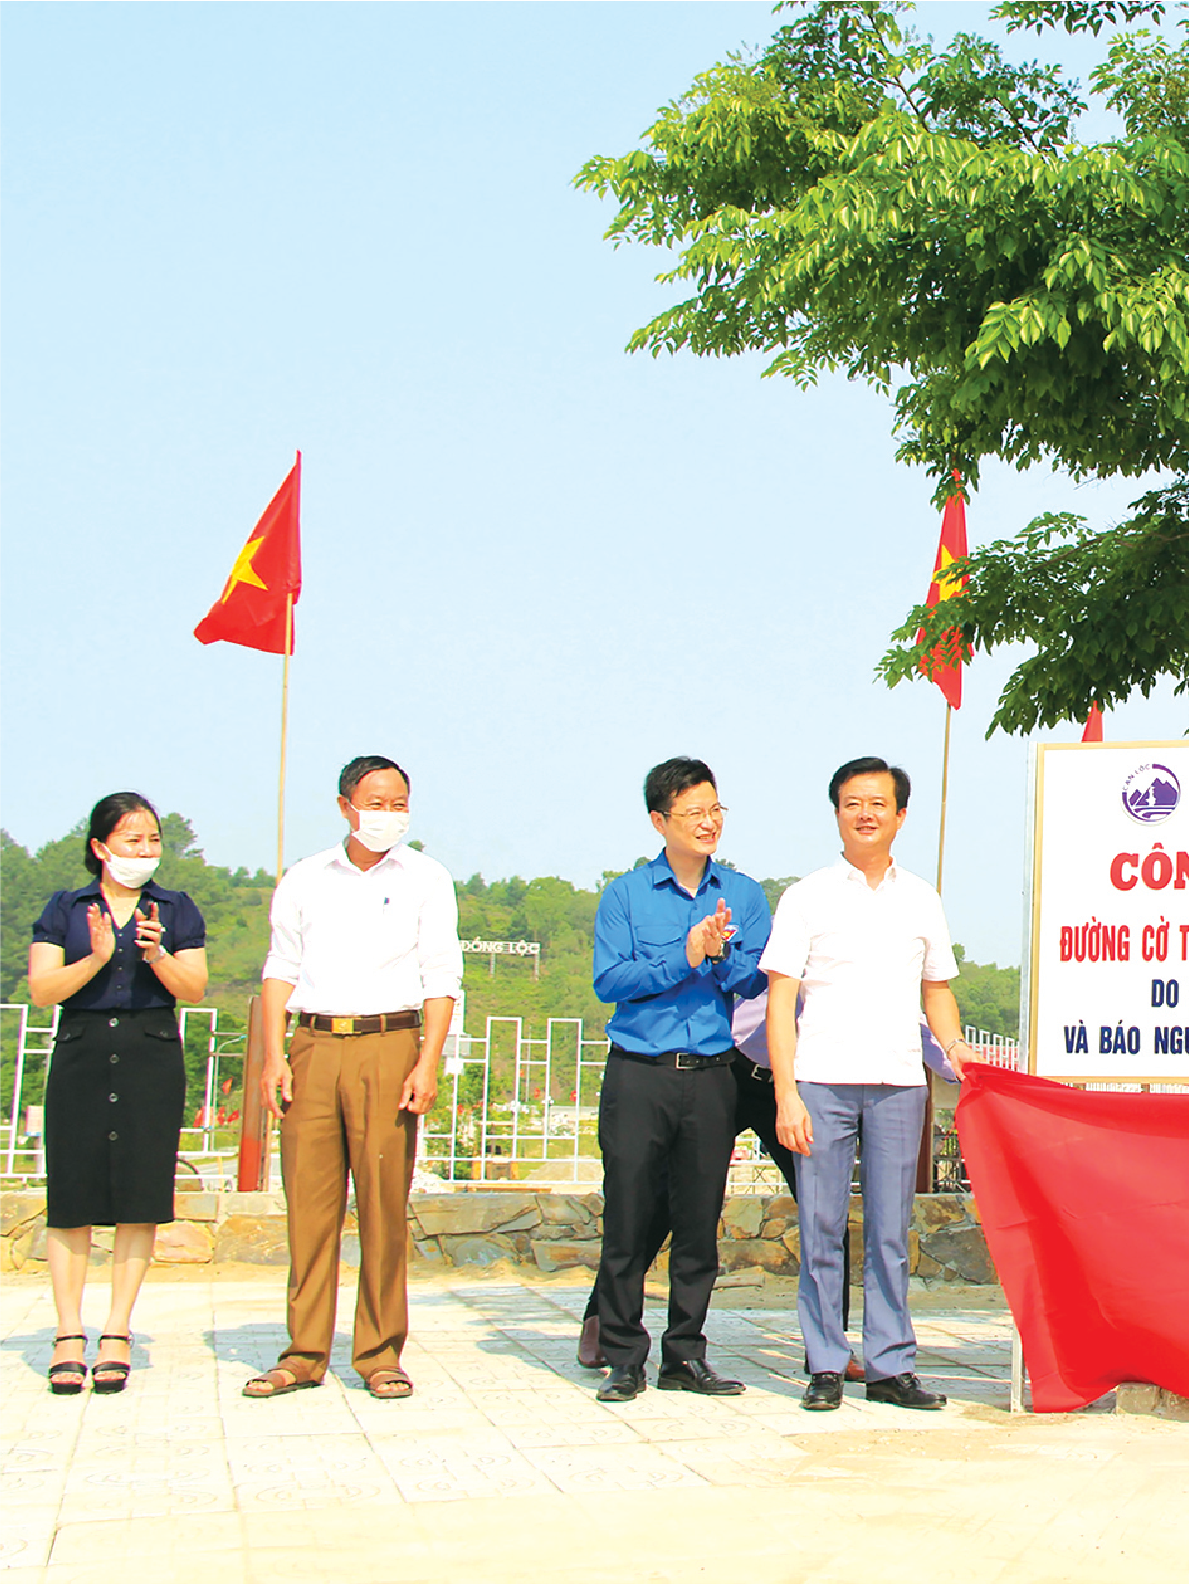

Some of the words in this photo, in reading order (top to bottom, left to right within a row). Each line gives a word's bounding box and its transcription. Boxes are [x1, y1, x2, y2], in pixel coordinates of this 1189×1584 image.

[1059, 916, 1130, 963] ĐƯỜNG
[1142, 915, 1170, 963] CỜ
[1151, 978, 1179, 1008] DO
[1063, 1019, 1089, 1054] VÀ
[1099, 1019, 1141, 1055] BÁO
